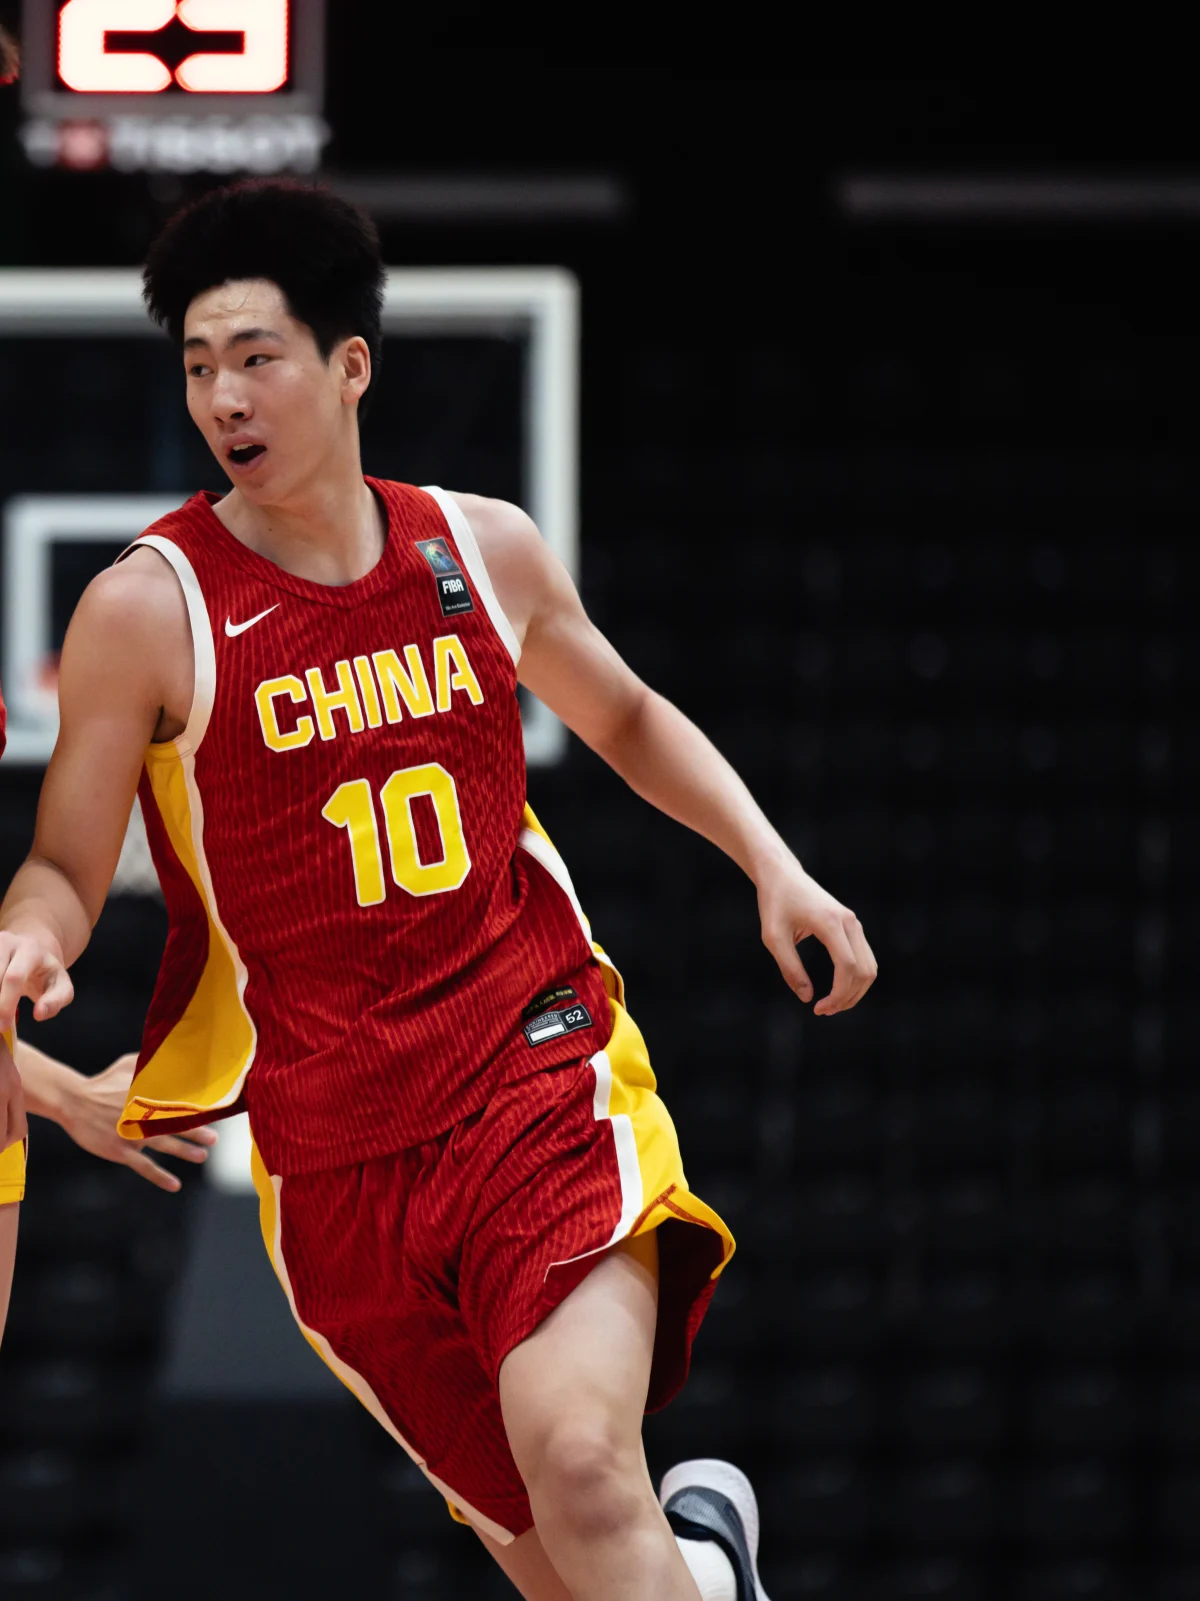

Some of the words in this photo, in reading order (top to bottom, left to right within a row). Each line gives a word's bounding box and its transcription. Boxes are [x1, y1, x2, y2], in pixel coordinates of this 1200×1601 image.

[442, 579, 464, 594] FIBA
[254, 634, 484, 753] CHINA
[321, 762, 471, 907] 10
[565, 1010, 584, 1024] 52
